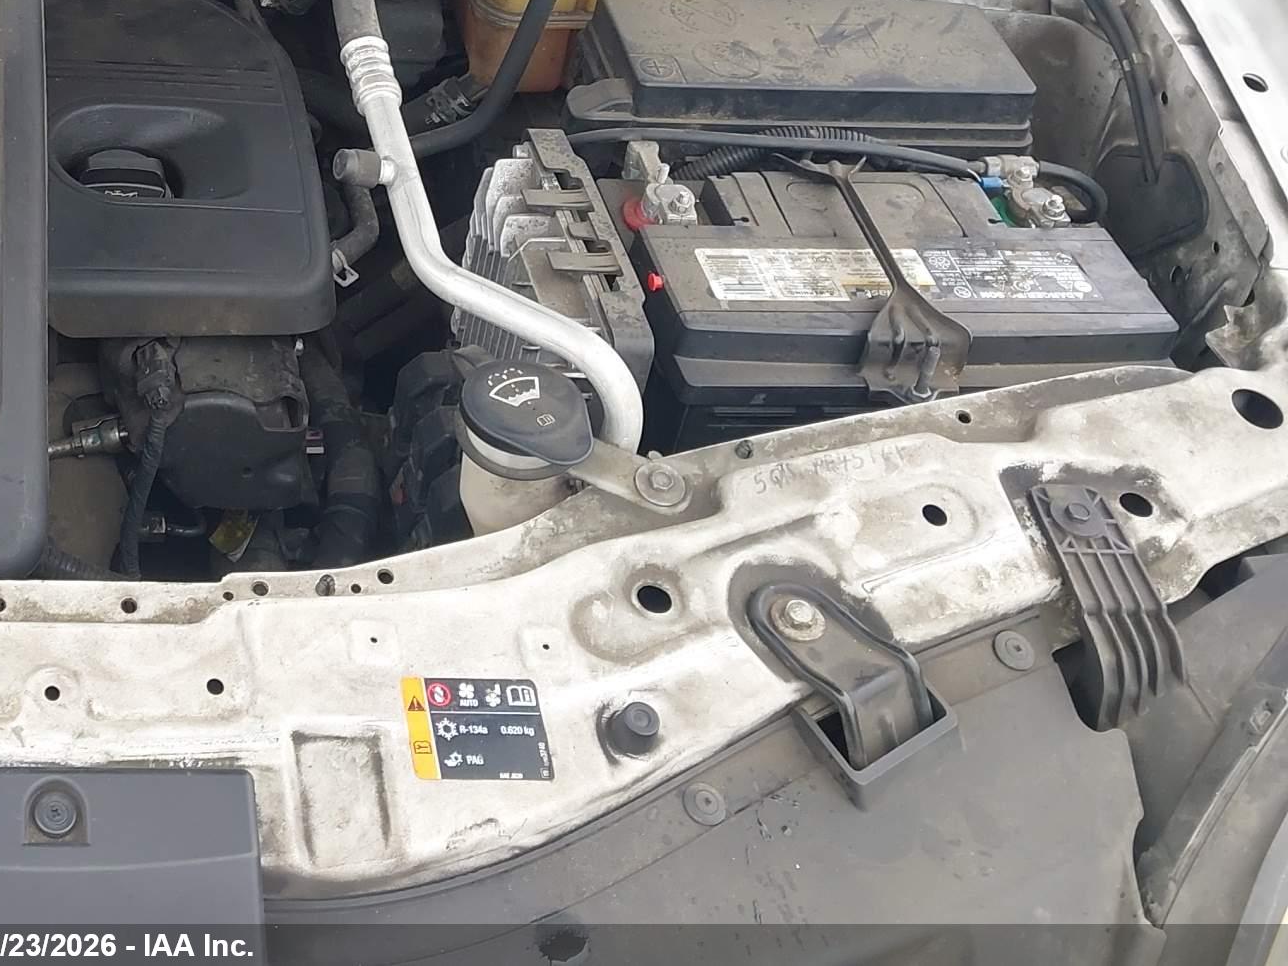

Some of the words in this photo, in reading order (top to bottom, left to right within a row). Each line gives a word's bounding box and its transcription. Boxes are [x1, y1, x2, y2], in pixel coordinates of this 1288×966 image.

[459, 699, 479, 707] AUTO
[459, 725, 488, 734] R-134a
[523, 726, 535, 737] kg
[466, 755, 484, 765] PAG
